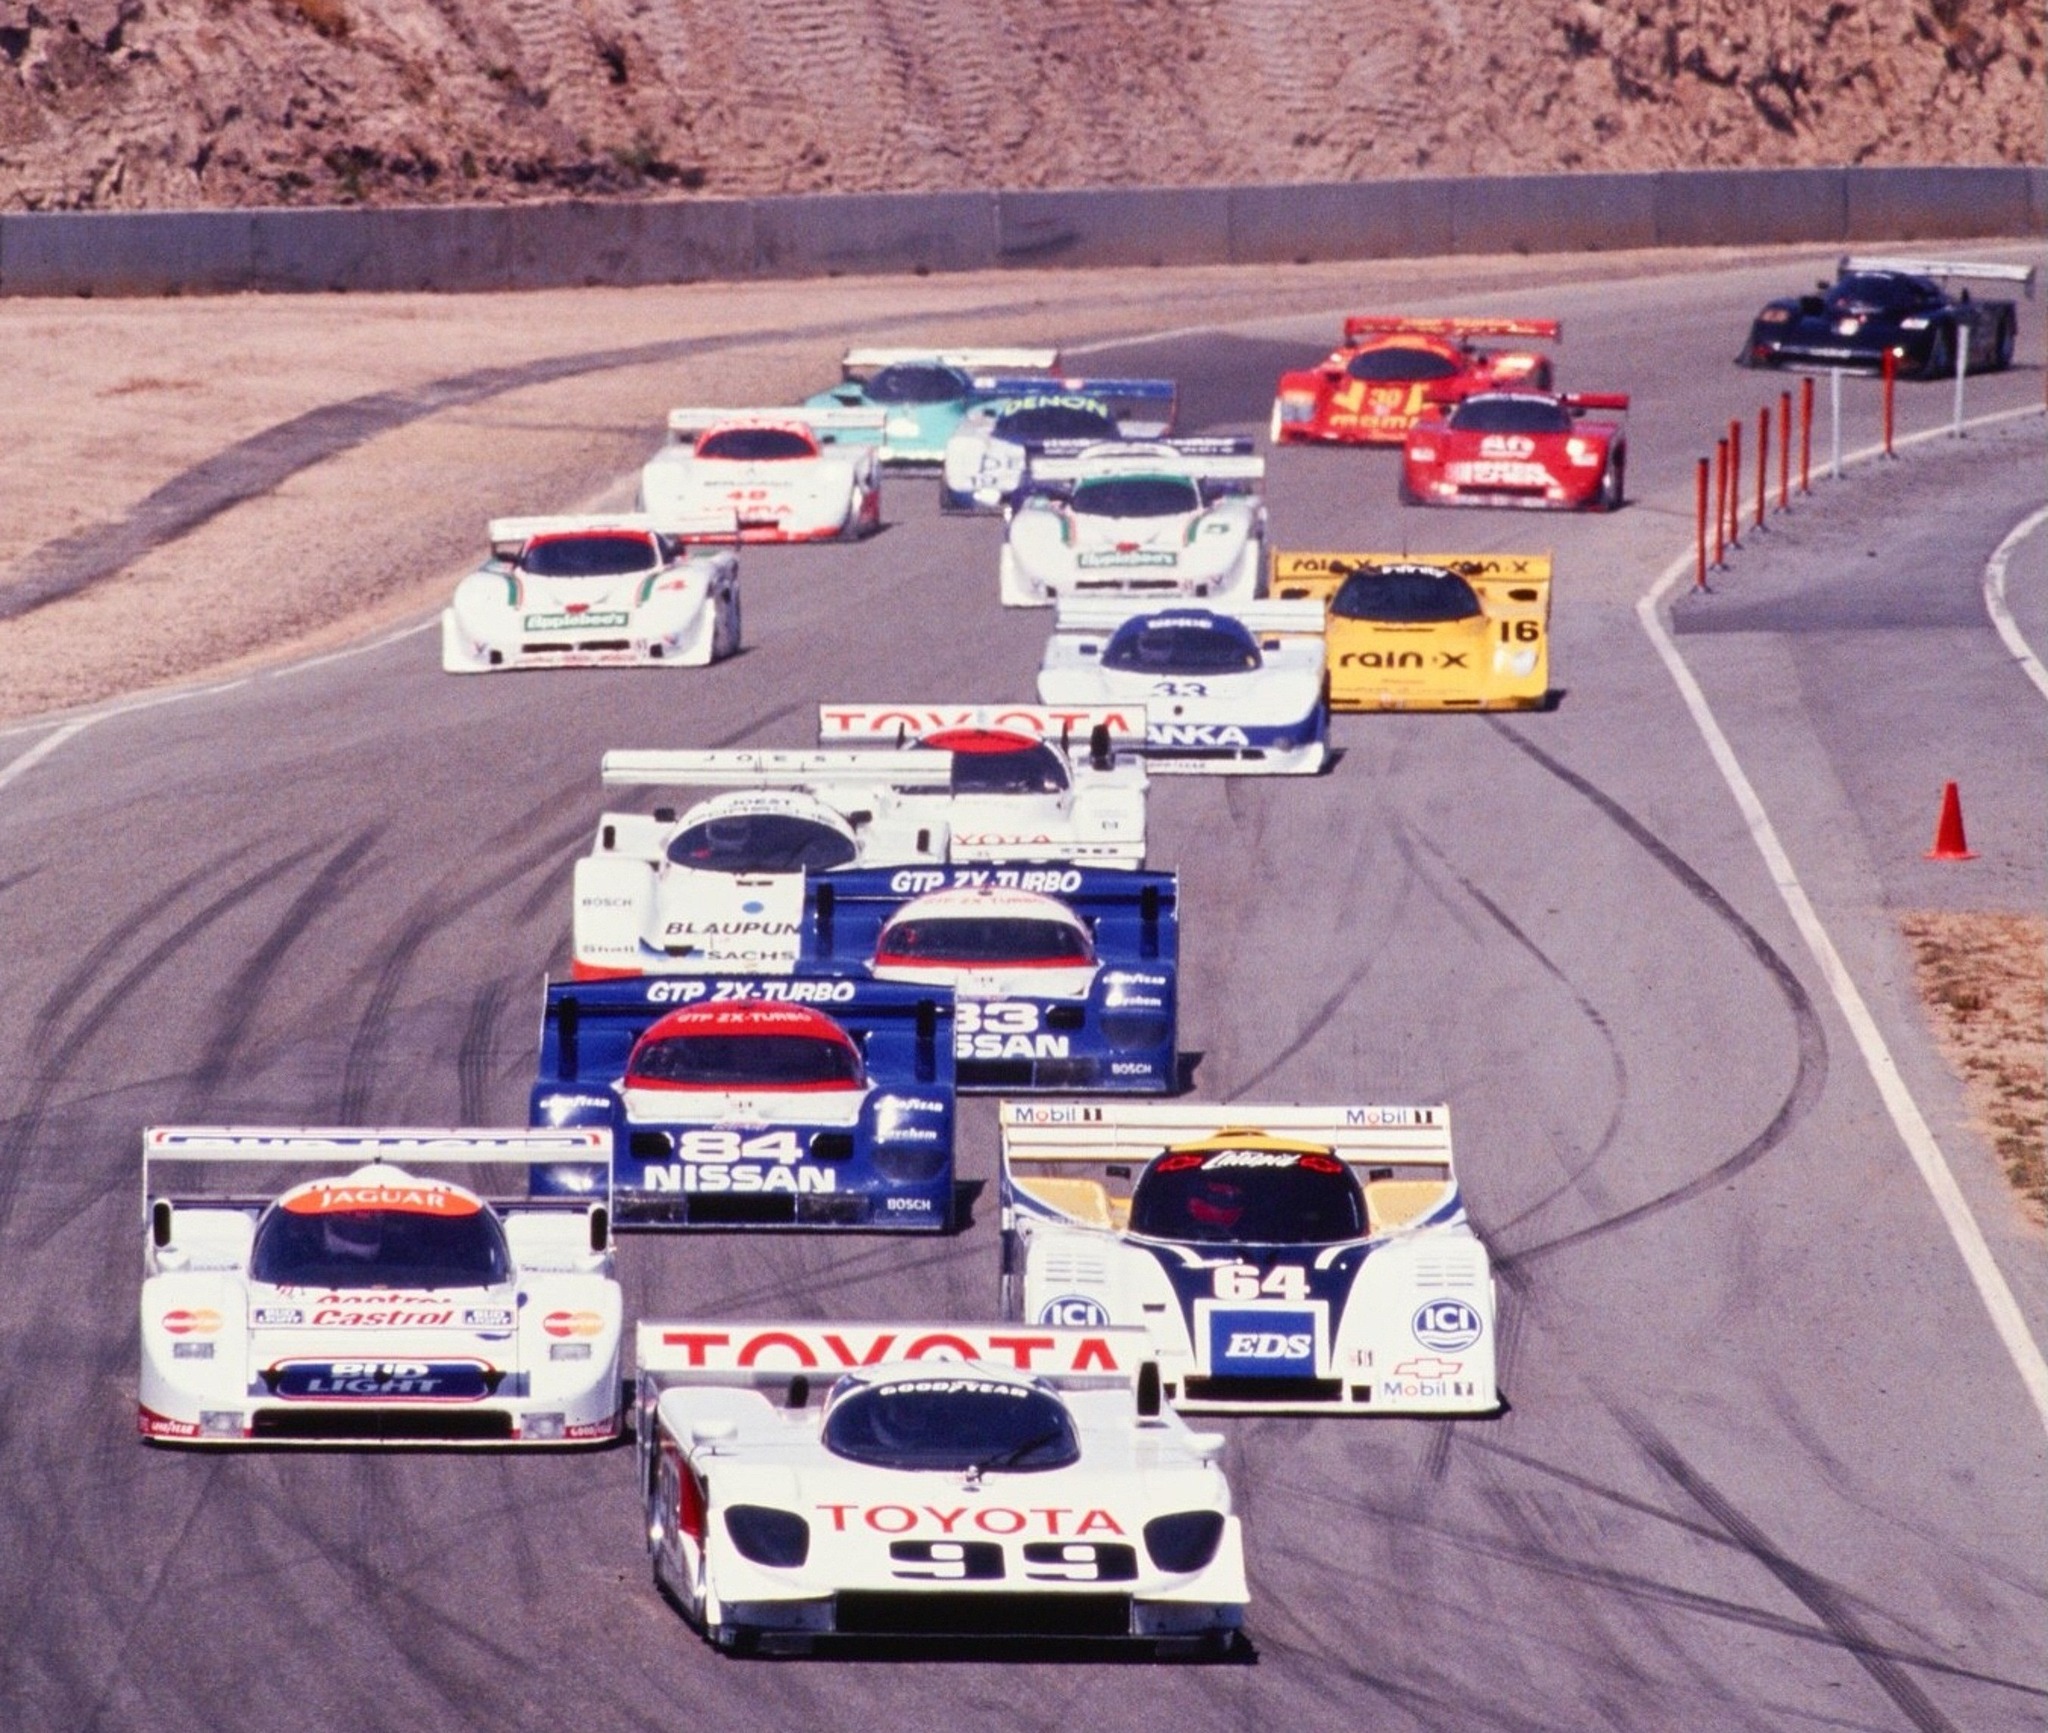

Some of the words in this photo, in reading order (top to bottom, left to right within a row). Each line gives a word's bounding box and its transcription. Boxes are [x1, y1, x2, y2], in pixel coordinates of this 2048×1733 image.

[1004, 396, 1108, 417] DENON
[1500, 620, 1540, 643] 16
[1152, 682, 1207, 696] 33
[825, 711, 1130, 733] TOYOTA
[1147, 725, 1249, 745] ANKA
[955, 833, 1051, 845] YOTA
[891, 870, 945, 893] GTP
[582, 898, 632, 907] BOSCH
[665, 922, 800, 936] BLAUPUN
[708, 951, 796, 961] SACHS
[647, 980, 706, 1003] GTP
[711, 980, 856, 1003] ZX-TURBO
[677, 1014, 714, 1023] GTP
[1111, 1063, 1152, 1075] BOSCH
[1016, 1107, 1076, 1122] Mobil
[1347, 1109, 1406, 1124] Mobil
[679, 1131, 803, 1164] 84
[644, 1164, 835, 1193] NISSAN
[320, 1189, 446, 1208] JAGUAR
[887, 1198, 931, 1211] BOSCH
[1214, 1264, 1311, 1301] 64
[312, 1310, 454, 1326] Castrol
[1052, 1304, 1097, 1326] ICI
[1425, 1306, 1468, 1331] ICI
[663, 1332, 1119, 1371] TOYOTA
[1225, 1333, 1312, 1359] EDS
[332, 1364, 428, 1379] BUD
[308, 1379, 442, 1393] LIGHT
[880, 1380, 1028, 1397] GOODYEAR
[1384, 1382, 1446, 1396] Mobil
[815, 1504, 1126, 1535] TOYOTA
[889, 1539, 1140, 1582] 99
